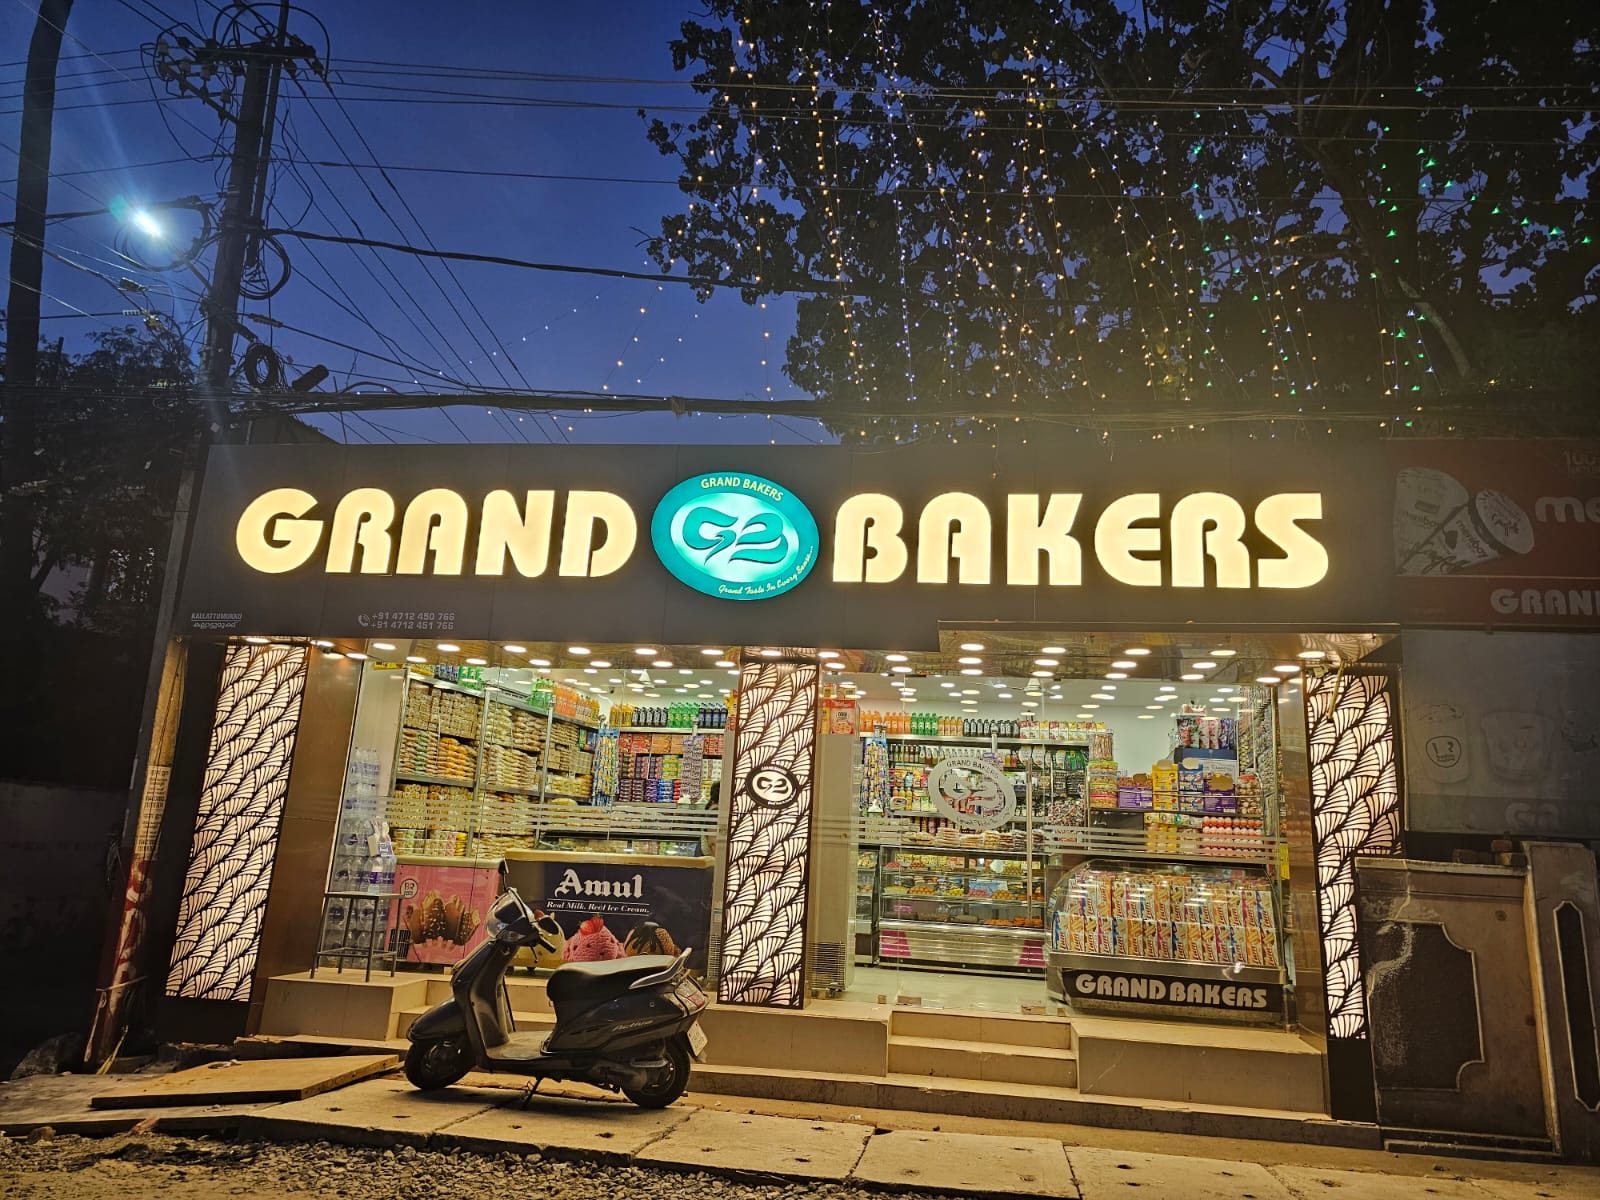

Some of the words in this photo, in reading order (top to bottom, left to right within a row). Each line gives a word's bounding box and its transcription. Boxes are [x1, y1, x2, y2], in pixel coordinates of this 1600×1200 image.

[701, 476, 741, 489] GRAND
[742, 478, 784, 502] BAKERS
[235, 487, 638, 578] GRAND
[832, 491, 1329, 589] BAKERS
[718, 583, 743, 595] Grand
[1490, 587, 1600, 617] GRAN
[390, 621, 414, 629] 4712
[416, 621, 433, 629] 451
[392, 612, 415, 620] 4712
[417, 612, 435, 620] 450
[946, 759, 971, 768] GRAND
[554, 868, 642, 898] Amul
[546, 901, 565, 909] Real
[566, 902, 586, 910] Milk.
[620, 905, 650, 913] Cream.
[1075, 973, 1167, 1001] GRAND
[1169, 981, 1268, 1009] BAKERS
